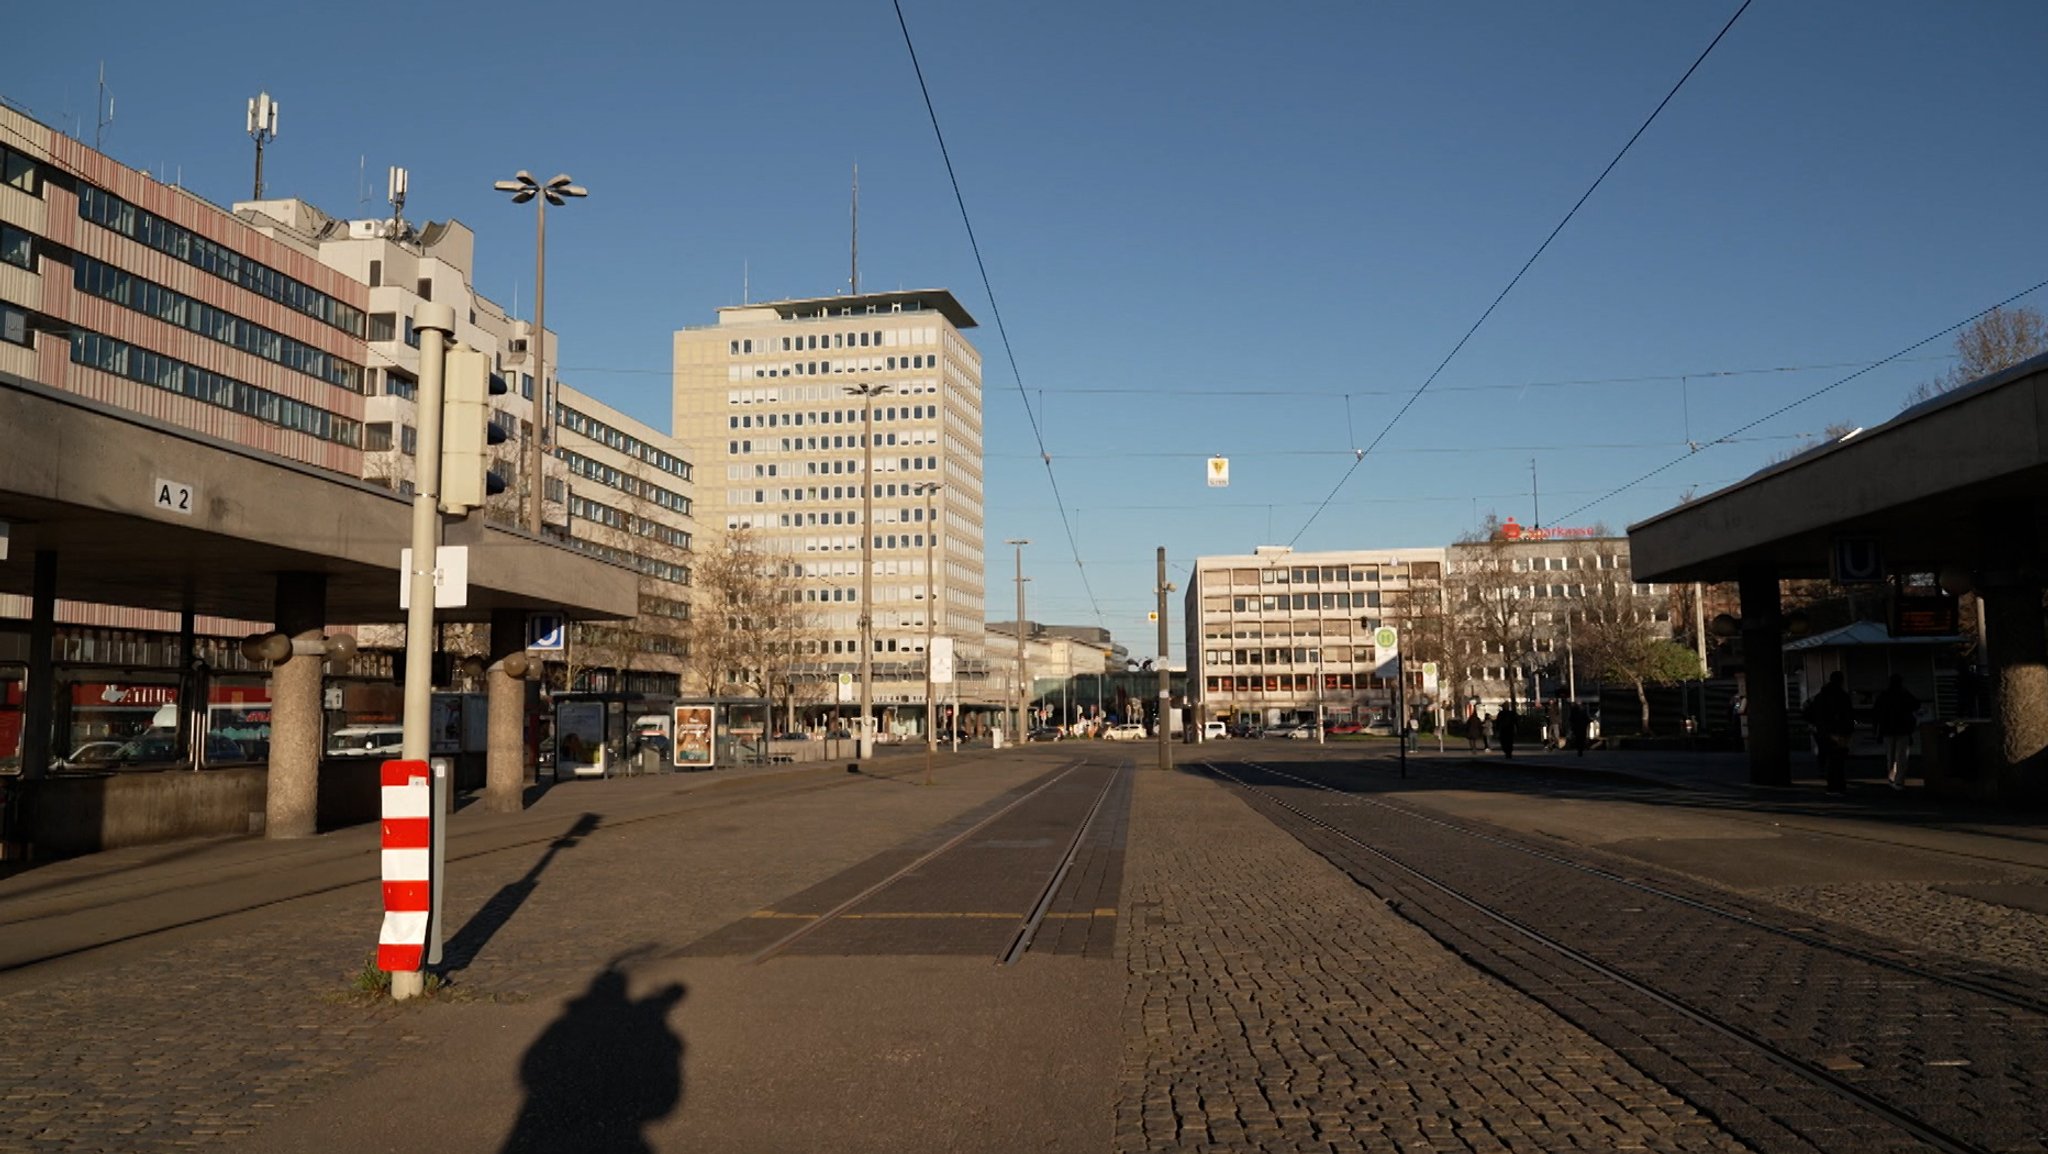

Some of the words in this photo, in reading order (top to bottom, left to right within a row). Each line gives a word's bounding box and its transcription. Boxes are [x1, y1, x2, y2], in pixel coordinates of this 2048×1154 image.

[159, 484, 171, 505] A
[179, 488, 188, 509] 2
[1527, 526, 1594, 538] Sparkasse
[1843, 541, 1876, 577] U
[535, 618, 558, 646] U
